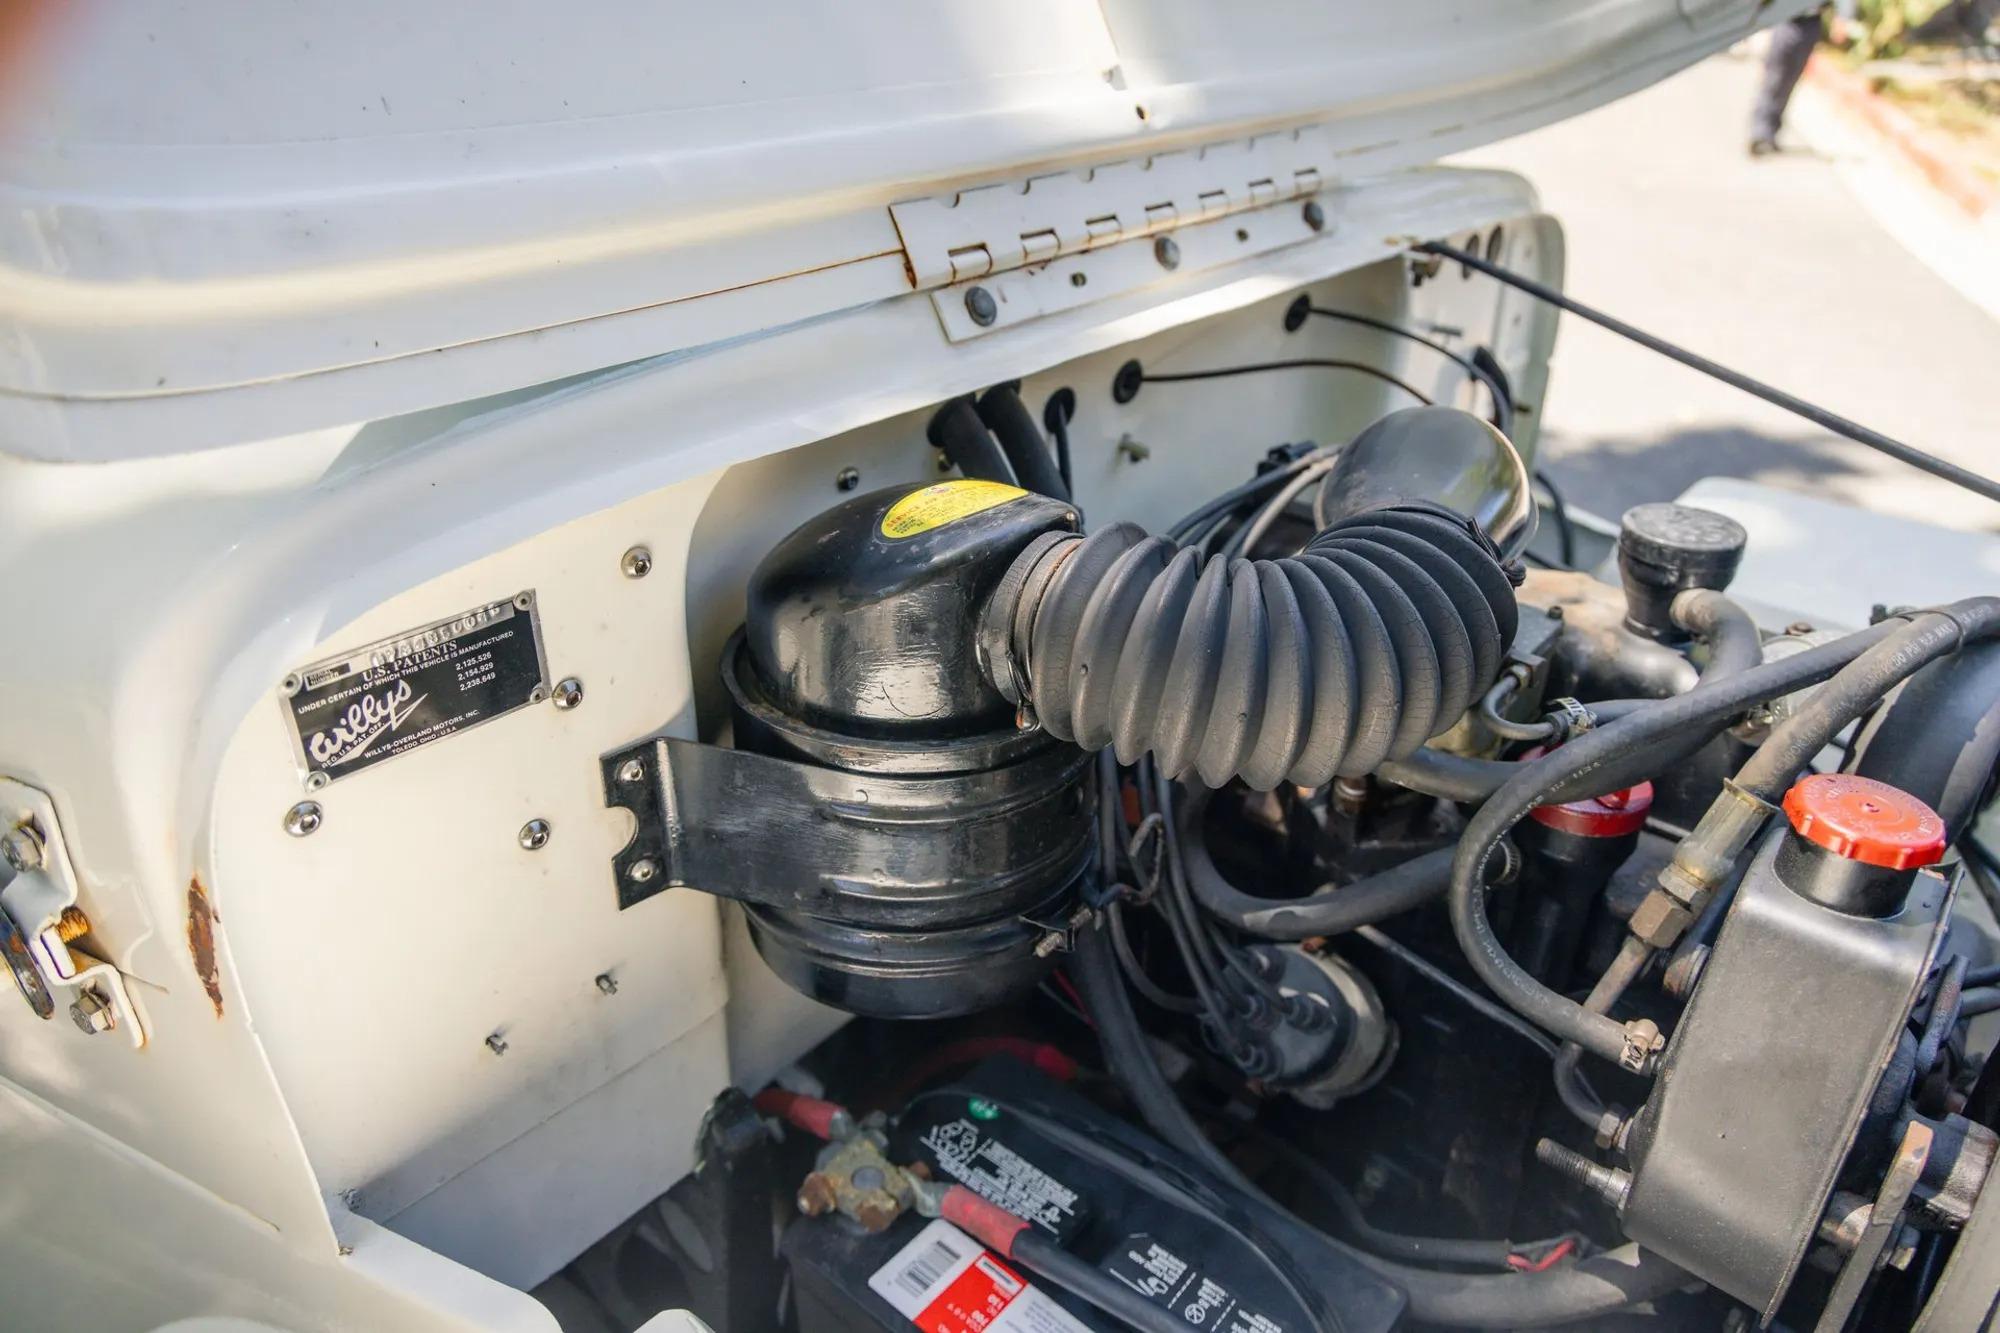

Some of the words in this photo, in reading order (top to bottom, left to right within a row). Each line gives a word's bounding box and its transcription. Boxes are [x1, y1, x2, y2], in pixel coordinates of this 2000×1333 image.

[298, 699, 327, 714] UNDER
[327, 686, 362, 703] CERTAIN
[363, 681, 375, 690] OF
[375, 673, 400, 686] WHICH
[401, 666, 418, 676] THIS
[419, 656, 450, 669] VEHICLE
[459, 631, 513, 655] MANUFACTURED
[362, 666, 391, 682] U.S.
[394, 640, 457, 671] PATENTS
[354, 734, 369, 746] PAT.
[364, 726, 432, 759] WILLYS-OVERLAND
[465, 709, 480, 718] INC.
[419, 734, 436, 745] OHIO
